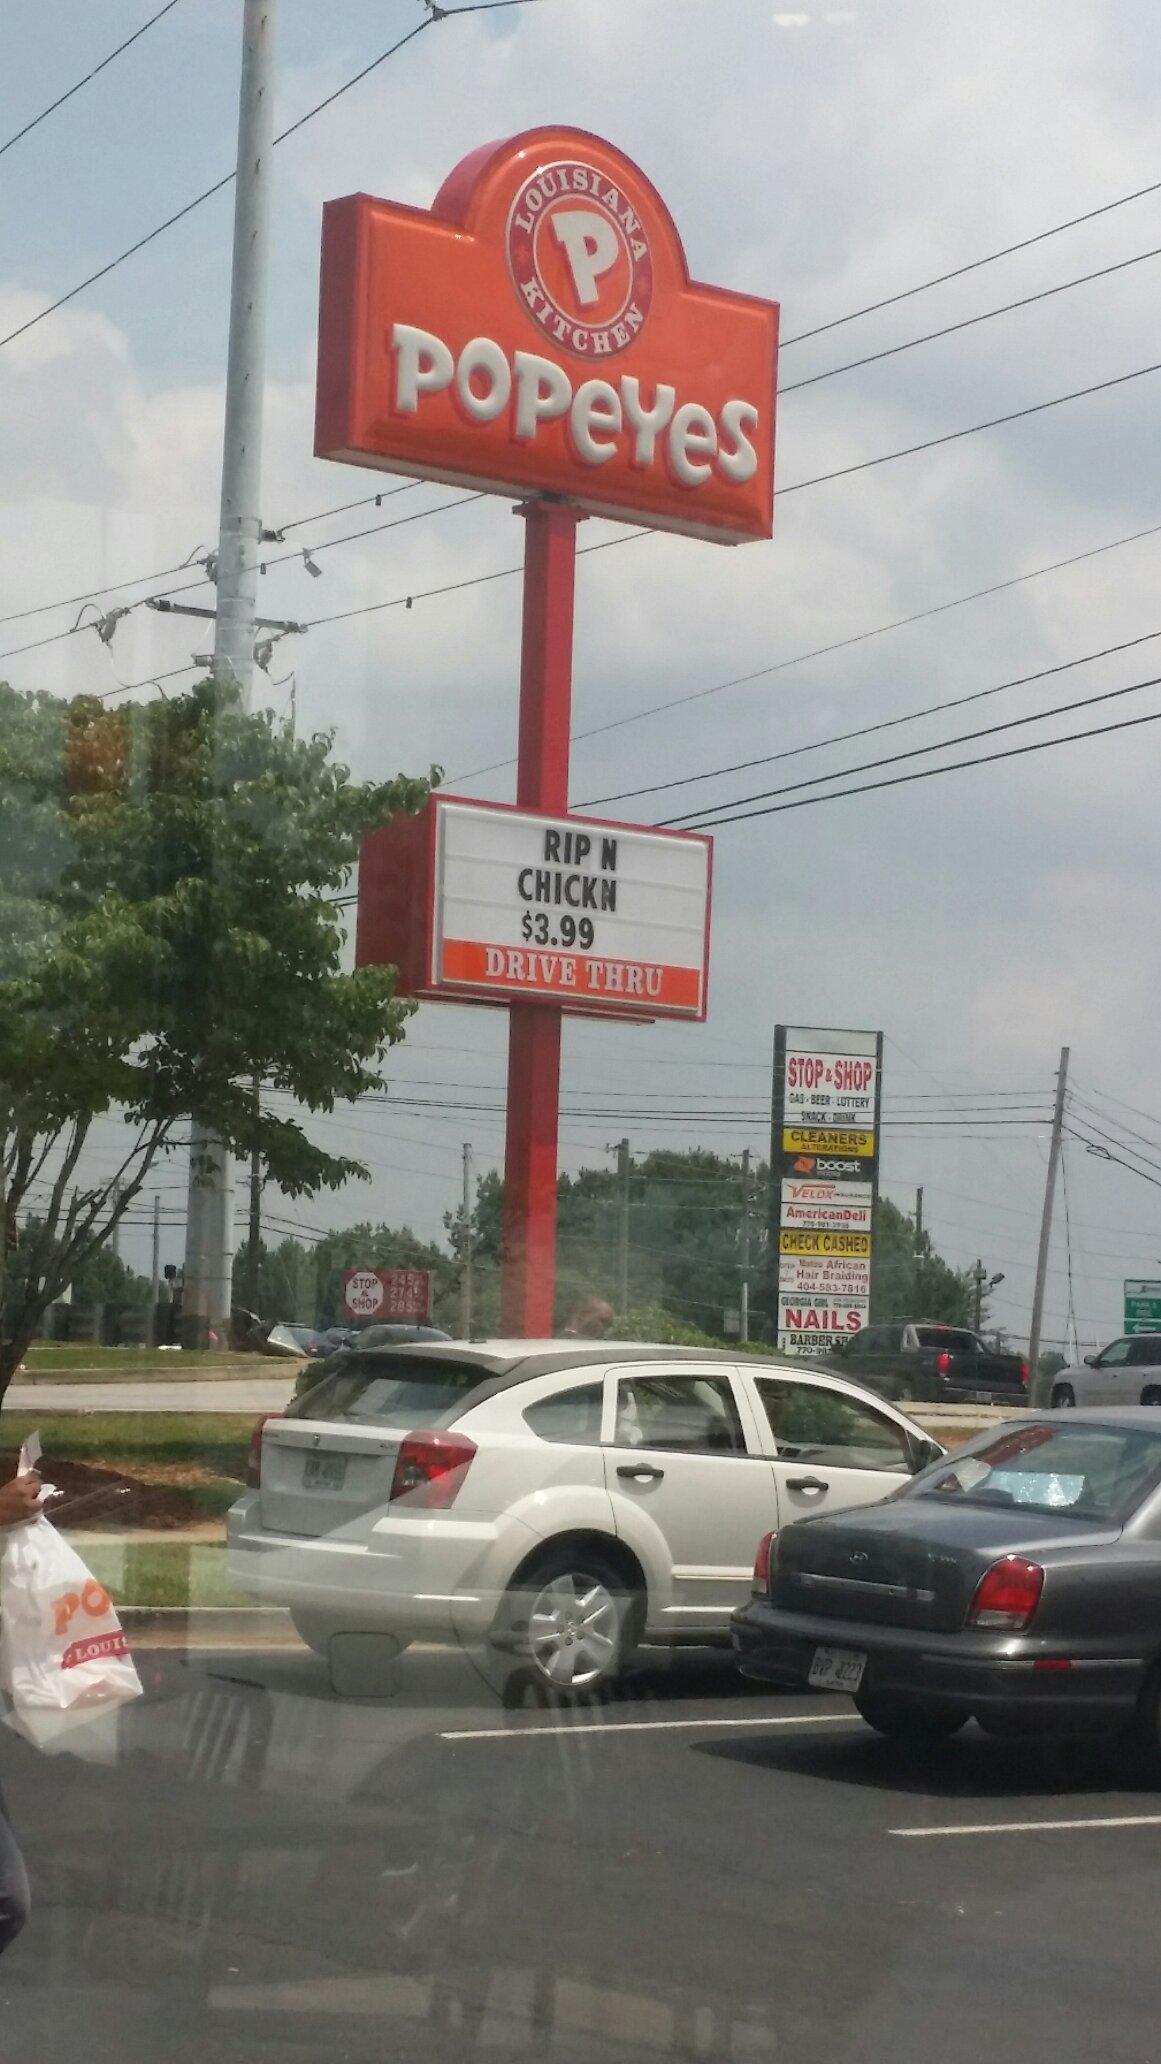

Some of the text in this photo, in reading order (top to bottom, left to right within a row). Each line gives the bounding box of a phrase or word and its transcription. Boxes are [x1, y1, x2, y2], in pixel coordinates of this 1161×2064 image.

[515, 166, 648, 262] LOUISIANA
[550, 210, 619, 305] P
[521, 276, 646, 356] KITCHEN
[543, 829, 618, 872] RIP N
[517, 867, 618, 912] CHICKN
[522, 910, 595, 951] $3.99
[486, 947, 664, 997] DRIVE THRU
[788, 1057, 872, 1091] STOP & SHOP
[789, 1093, 870, 1108] GAS BEER LOTTERY
[791, 1130, 867, 1146] CLEANERS
[816, 1157, 861, 1173] boost
[782, 1233, 868, 1253] CHECK CASHED
[826, 1259, 866, 1271] African
[352, 1277, 378, 1289] STOP
[796, 1269, 869, 1283] Hair Braiding
[352, 1298, 378, 1310] SHOP
[785, 1308, 862, 1331] NAILS
[790, 1334, 833, 1346] BARBER
